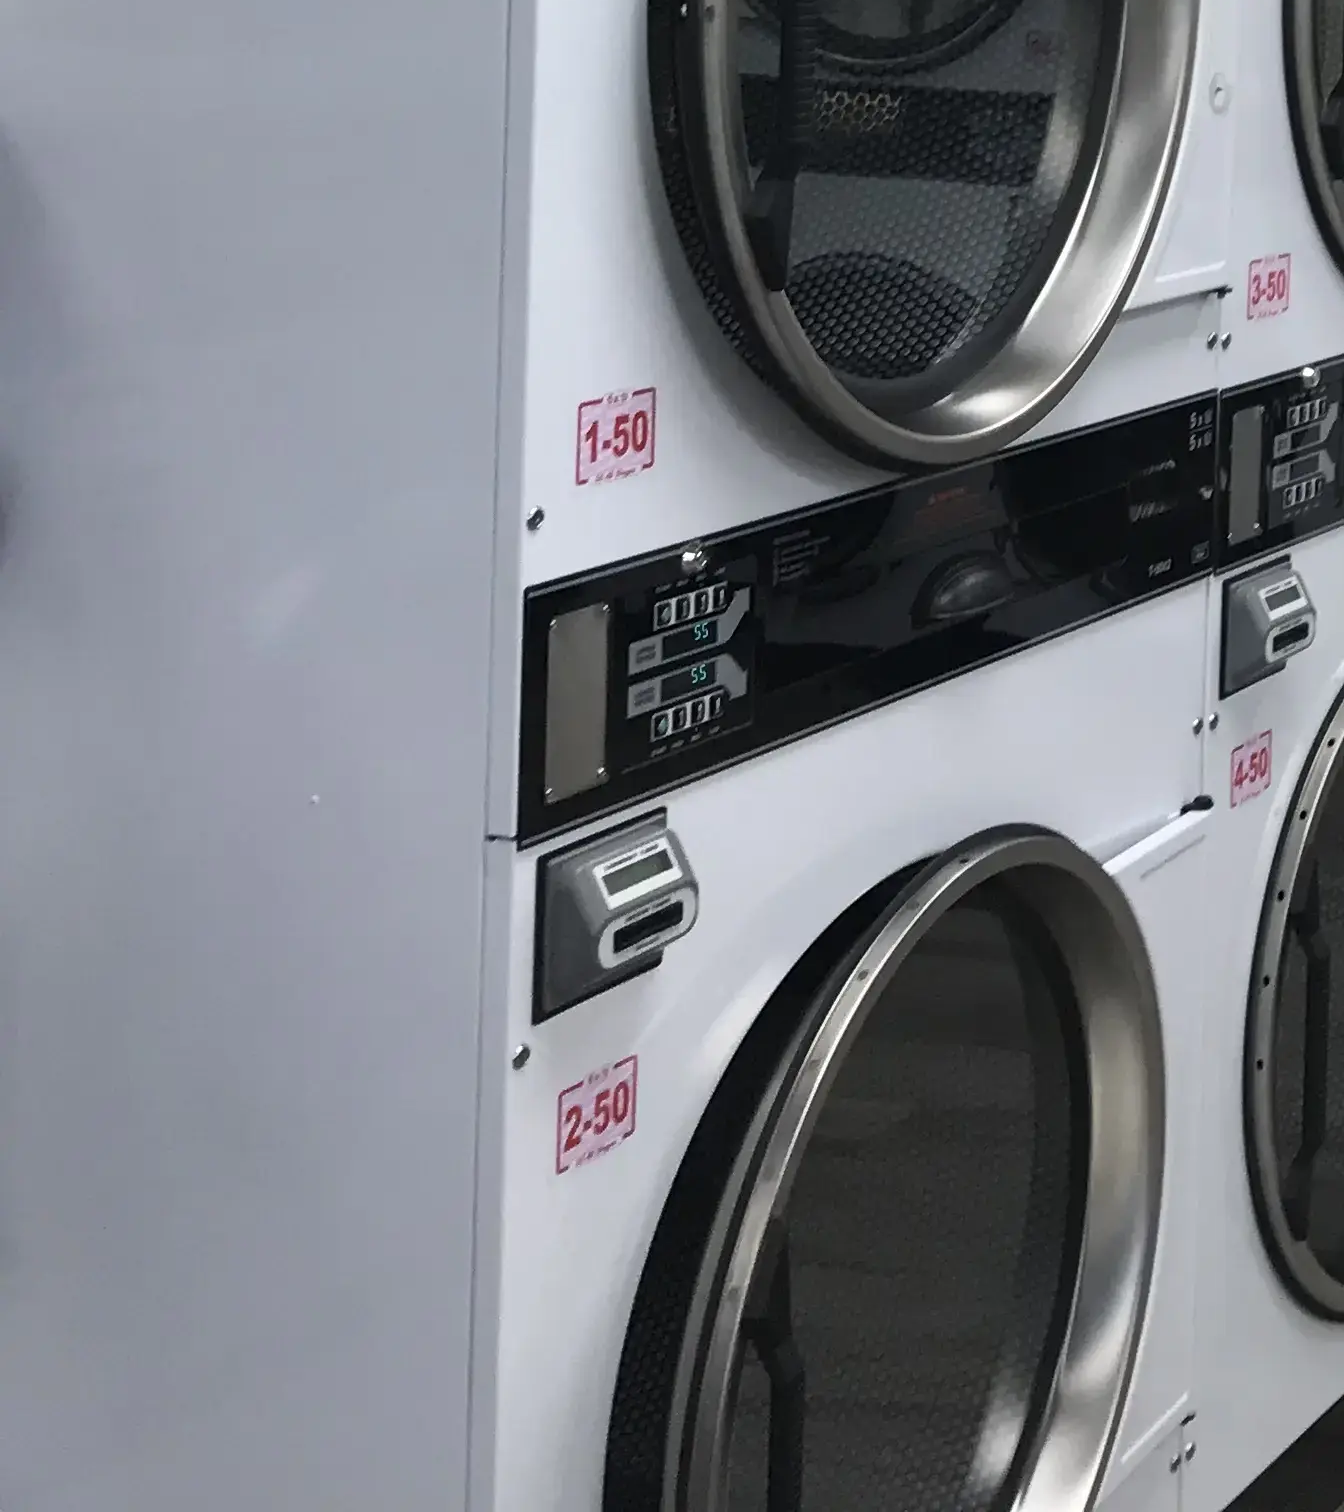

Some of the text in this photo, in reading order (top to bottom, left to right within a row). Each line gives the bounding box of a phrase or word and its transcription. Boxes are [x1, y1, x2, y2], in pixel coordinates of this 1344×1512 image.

[1251, 270, 1287, 305] 3-50
[585, 410, 649, 463] 1-50
[693, 622, 709, 640] 55
[691, 663, 707, 684] 55
[1233, 750, 1268, 788] 4-50
[563, 1081, 630, 1153] 2-50
